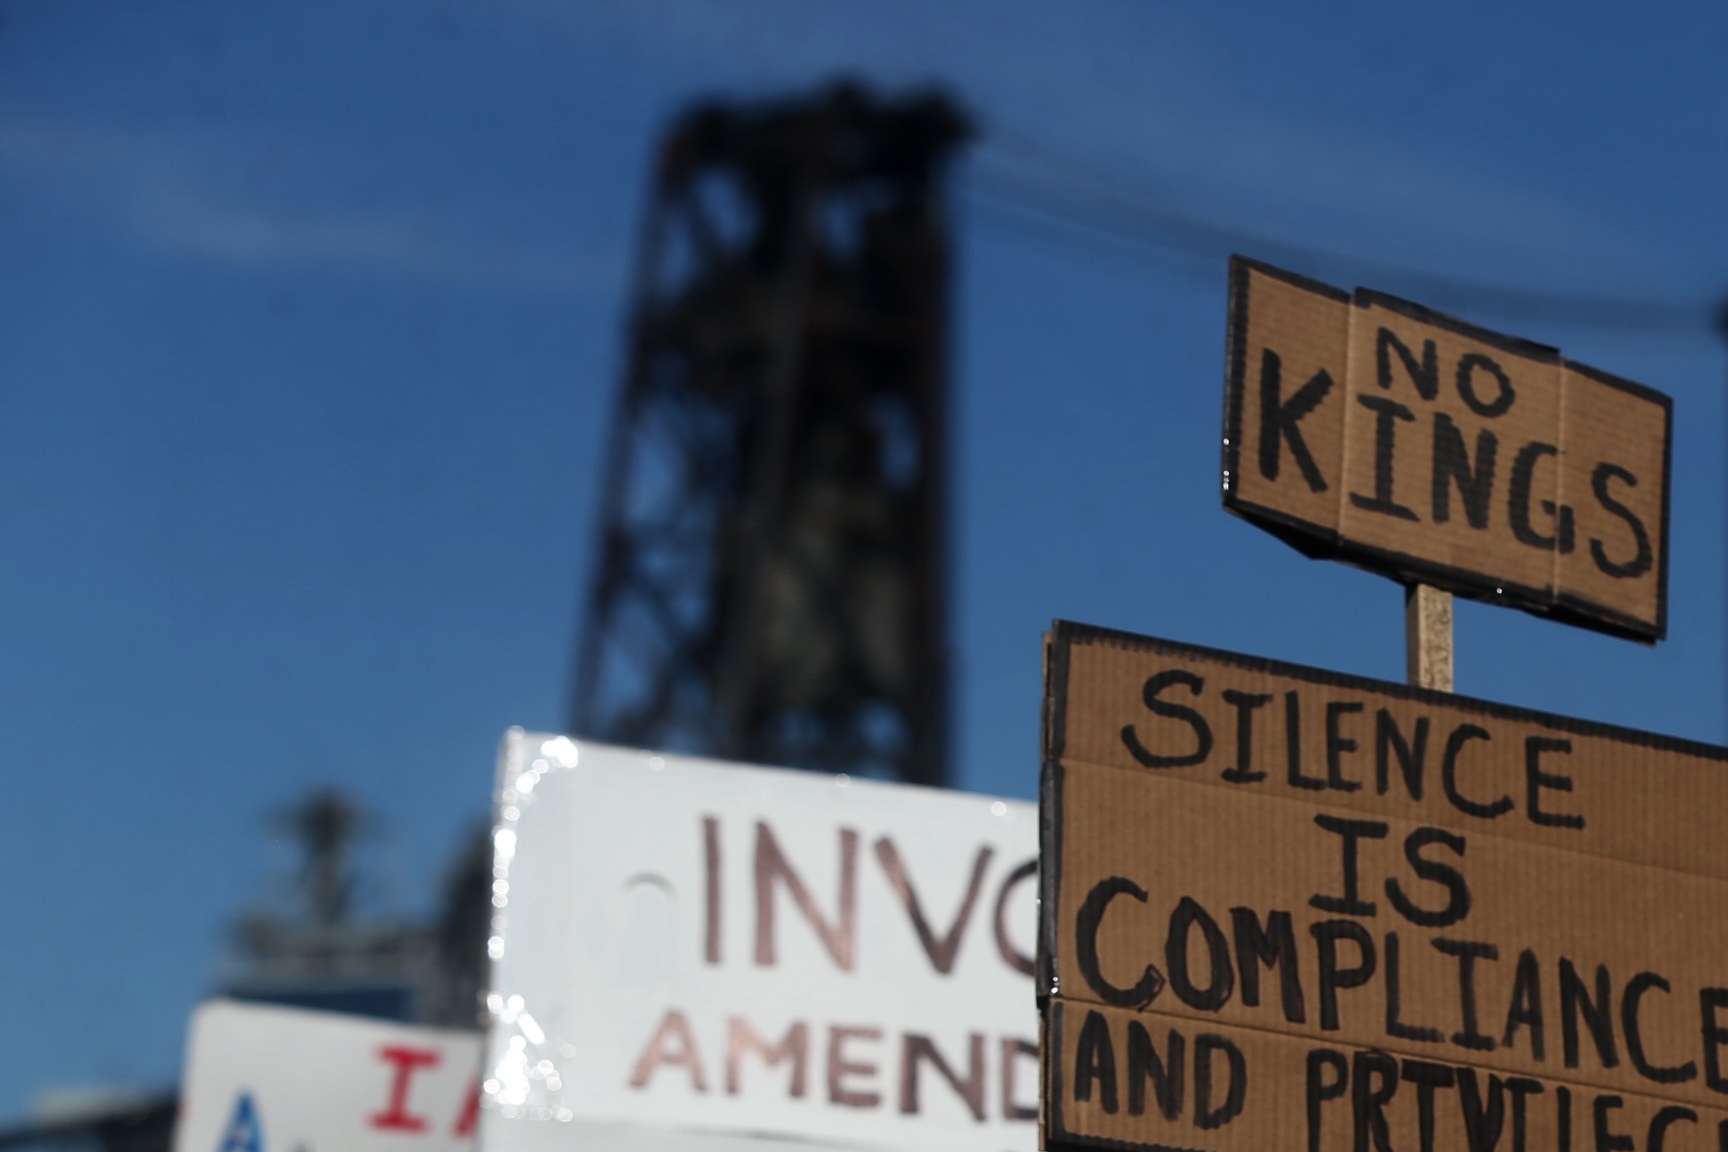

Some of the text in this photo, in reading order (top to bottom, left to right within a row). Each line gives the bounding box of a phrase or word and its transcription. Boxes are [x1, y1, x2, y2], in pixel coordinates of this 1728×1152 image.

[1376, 327, 1516, 418] NO
[1259, 347, 1654, 579] KINGS
[1121, 670, 1585, 829] SILENCE
[1309, 814, 1472, 928] IS
[1073, 1010, 1247, 1129] AND
